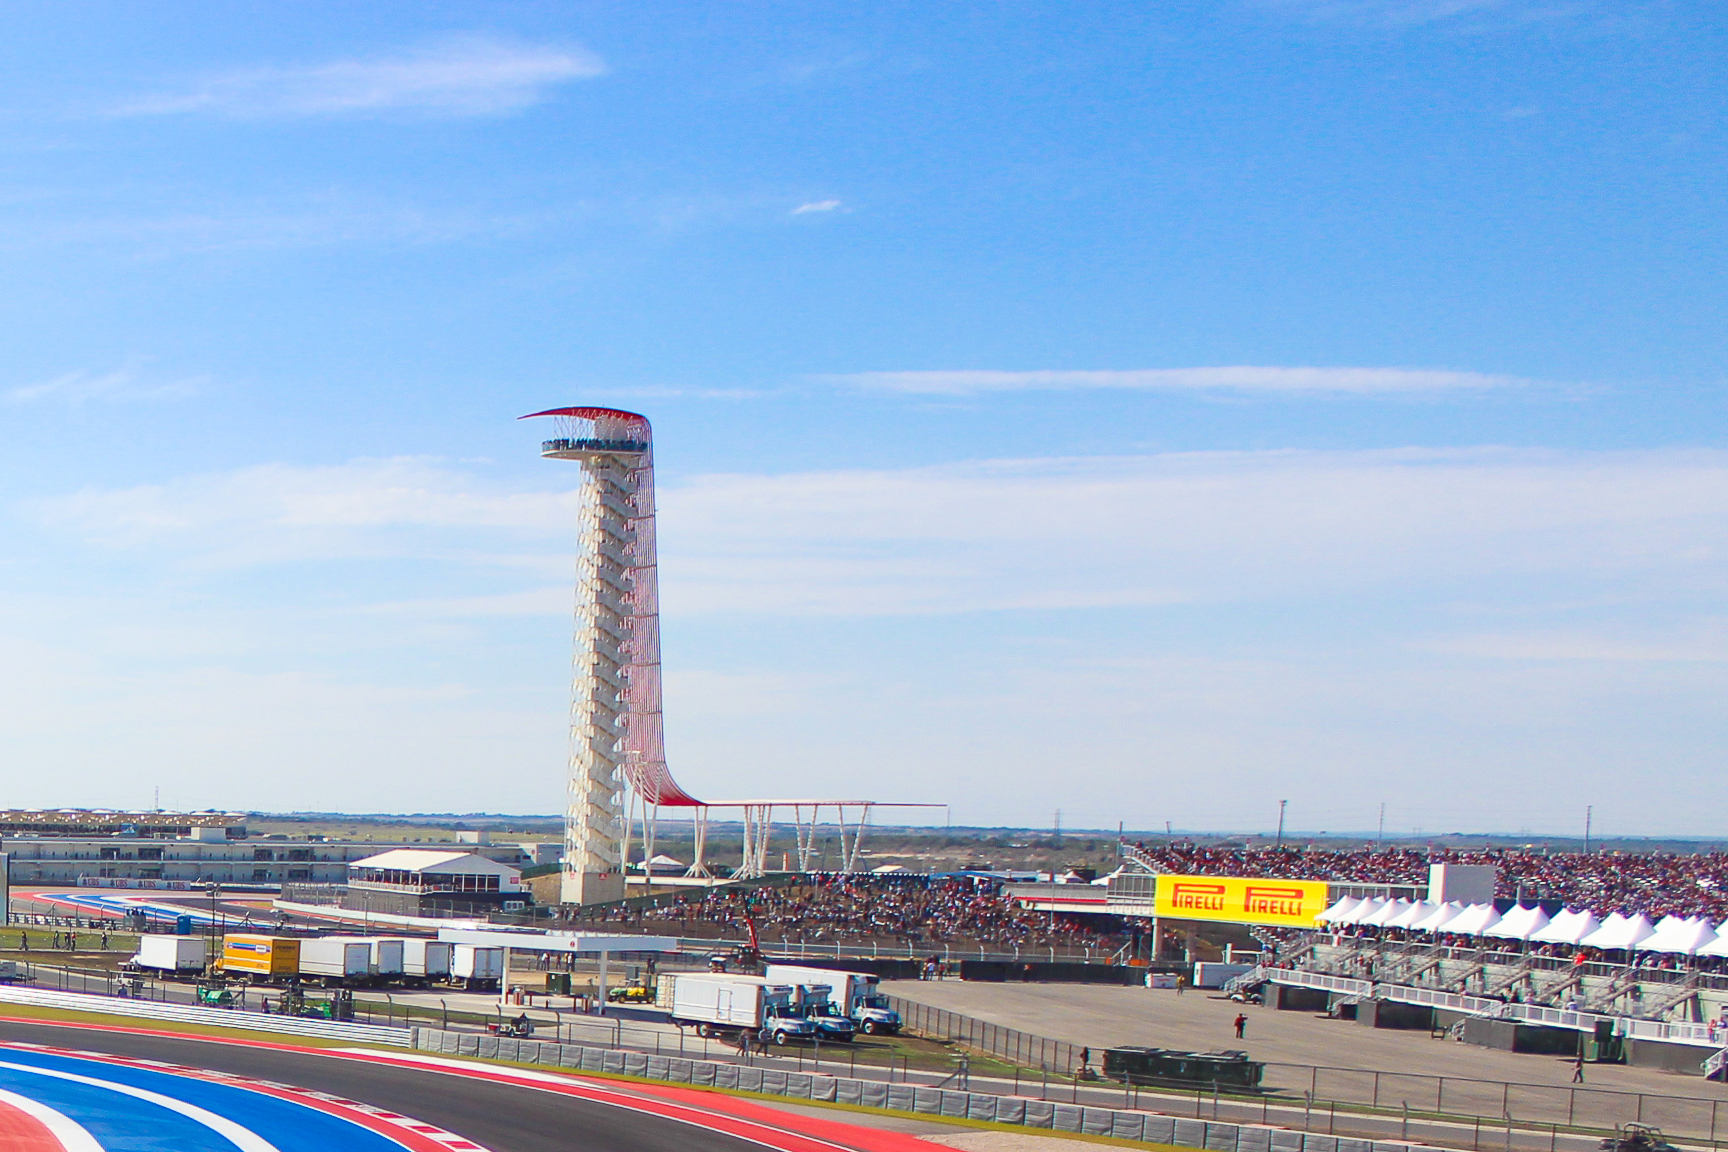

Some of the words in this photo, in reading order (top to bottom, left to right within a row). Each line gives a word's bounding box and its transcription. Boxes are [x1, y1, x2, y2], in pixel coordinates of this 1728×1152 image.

[88, 878, 100, 886] UBS
[115, 879, 128, 887] UBS
[143, 880, 156, 888] UBS
[172, 881, 186, 889] UBS
[1172, 883, 1226, 911] PIRELLI
[1244, 886, 1304, 916] PIRELLI
